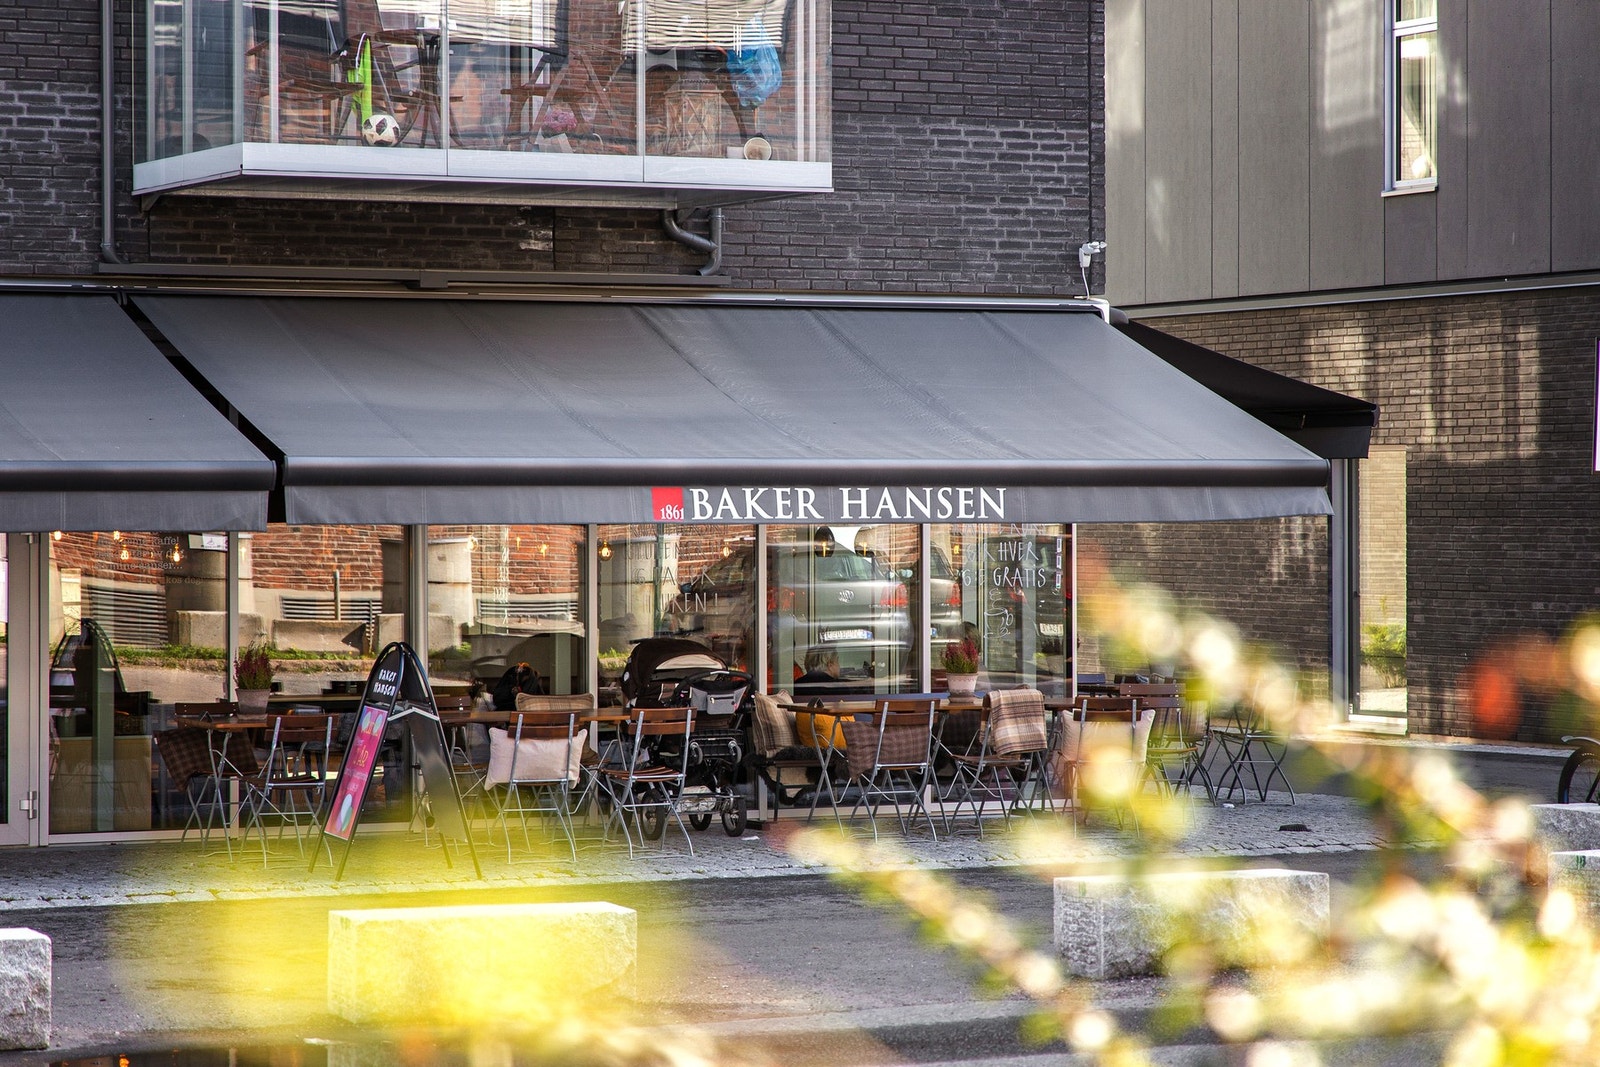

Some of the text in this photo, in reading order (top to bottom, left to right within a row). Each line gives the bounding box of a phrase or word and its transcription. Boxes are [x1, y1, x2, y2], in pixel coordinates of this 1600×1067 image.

[660, 505, 685, 520] 1861
[689, 487, 1007, 520] BAKER HANSEN
[997, 541, 1040, 562] HVER
[993, 564, 1047, 588] GRATIS
